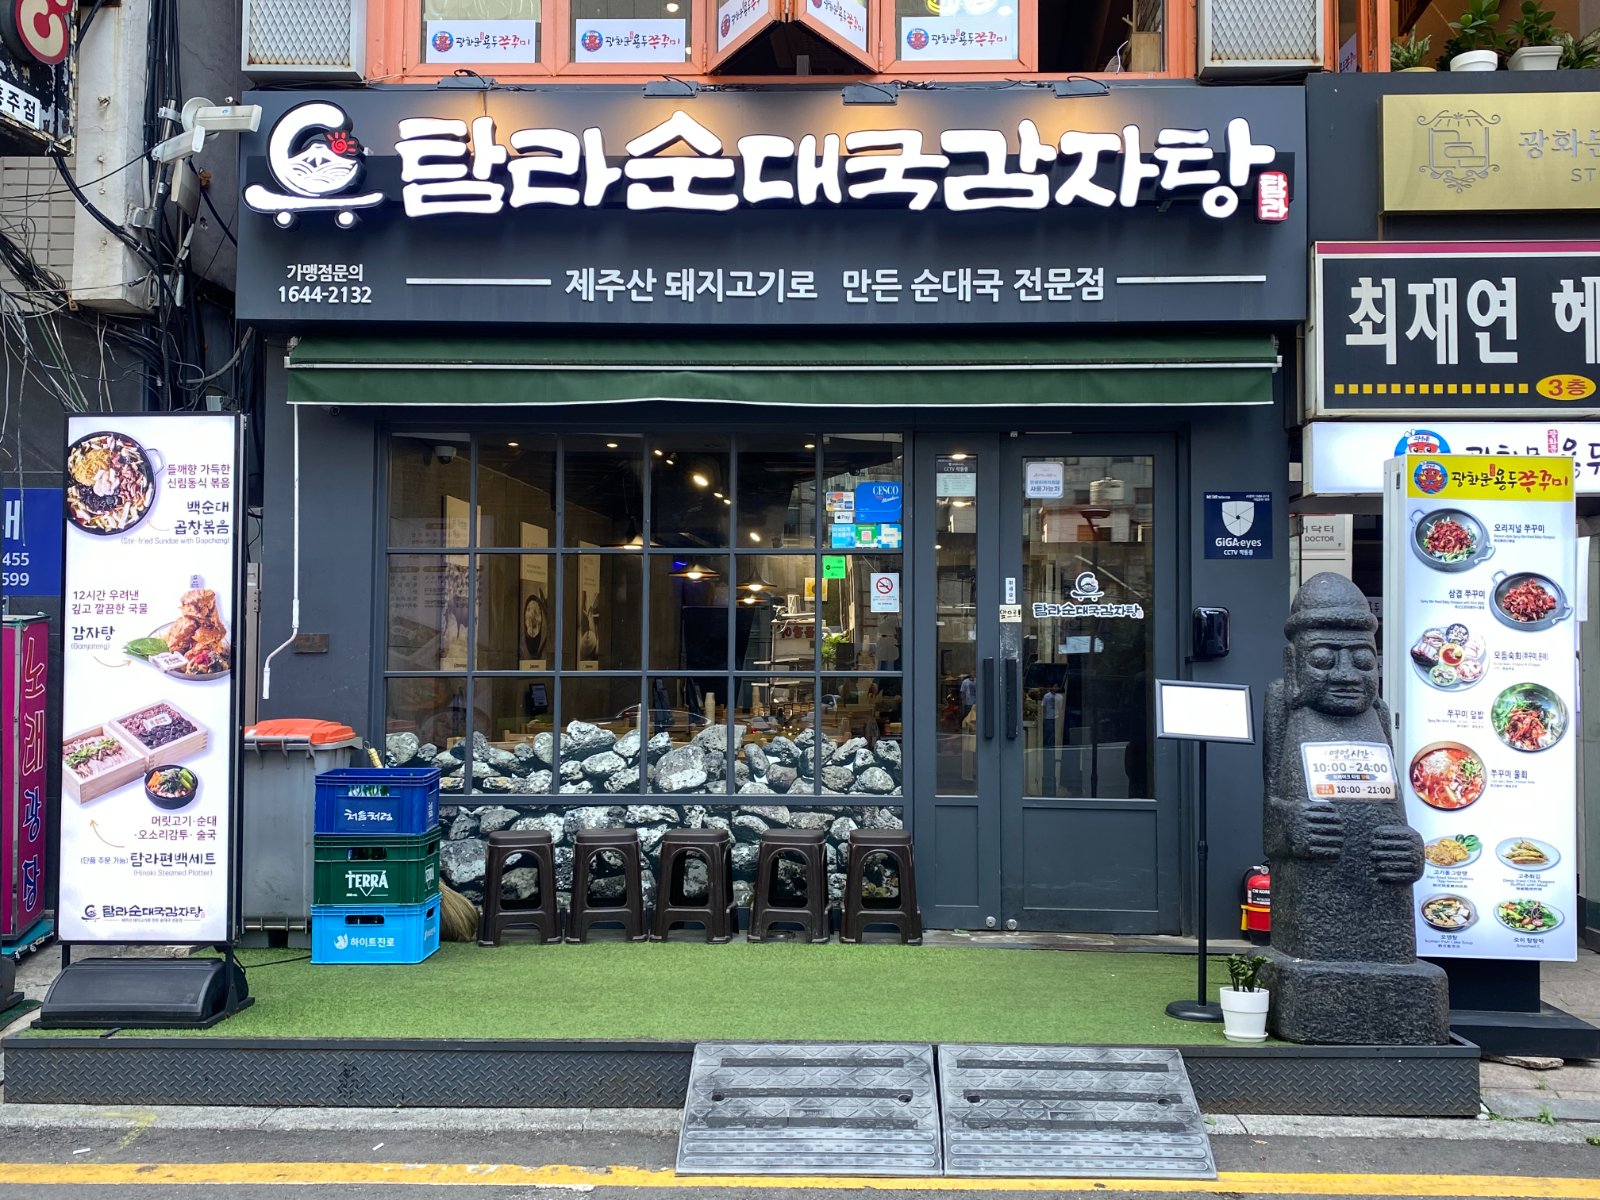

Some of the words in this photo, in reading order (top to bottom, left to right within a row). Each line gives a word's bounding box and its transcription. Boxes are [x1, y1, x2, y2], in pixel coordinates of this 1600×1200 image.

[1571, 168, 1600, 182] ST
[286, 263, 363, 283] 가맹점문의
[565, 267, 657, 302] 제주산
[664, 267, 818, 303] 돼지고기로
[842, 267, 902, 302] 만든
[910, 267, 1004, 302] 순대국
[1013, 266, 1105, 302] 전문점
[278, 285, 371, 303] 1644-2132
[1345, 276, 1519, 365] 최재연
[1548, 379, 1588, 396] 3층
[167, 464, 198, 475] 들깨향
[200, 463, 230, 475] 가득한
[210, 478, 230, 489] 볶음
[872, 485, 899, 496] CESCO
[187, 500, 229, 516] 백순대
[174, 519, 230, 536] 곱창볶음
[72, 590, 106, 601] 12시간
[109, 590, 139, 601] 우려낸
[72, 603, 92, 615] 깊고
[95, 603, 126, 614] 깔끔한
[128, 603, 149, 615] 국물
[71, 625, 116, 641] 감자탕
[1312, 762, 1347, 773] 10:00
[1356, 762, 1388, 773] 24:00
[1336, 786, 1361, 794] 10:00
[1367, 786, 1391, 794] 21:00
[196, 829, 217, 841] 술국
[130, 852, 217, 867] 탐라편백세트
[345, 871, 389, 889] TERRA
[350, 936, 395, 948] 하이트진로
